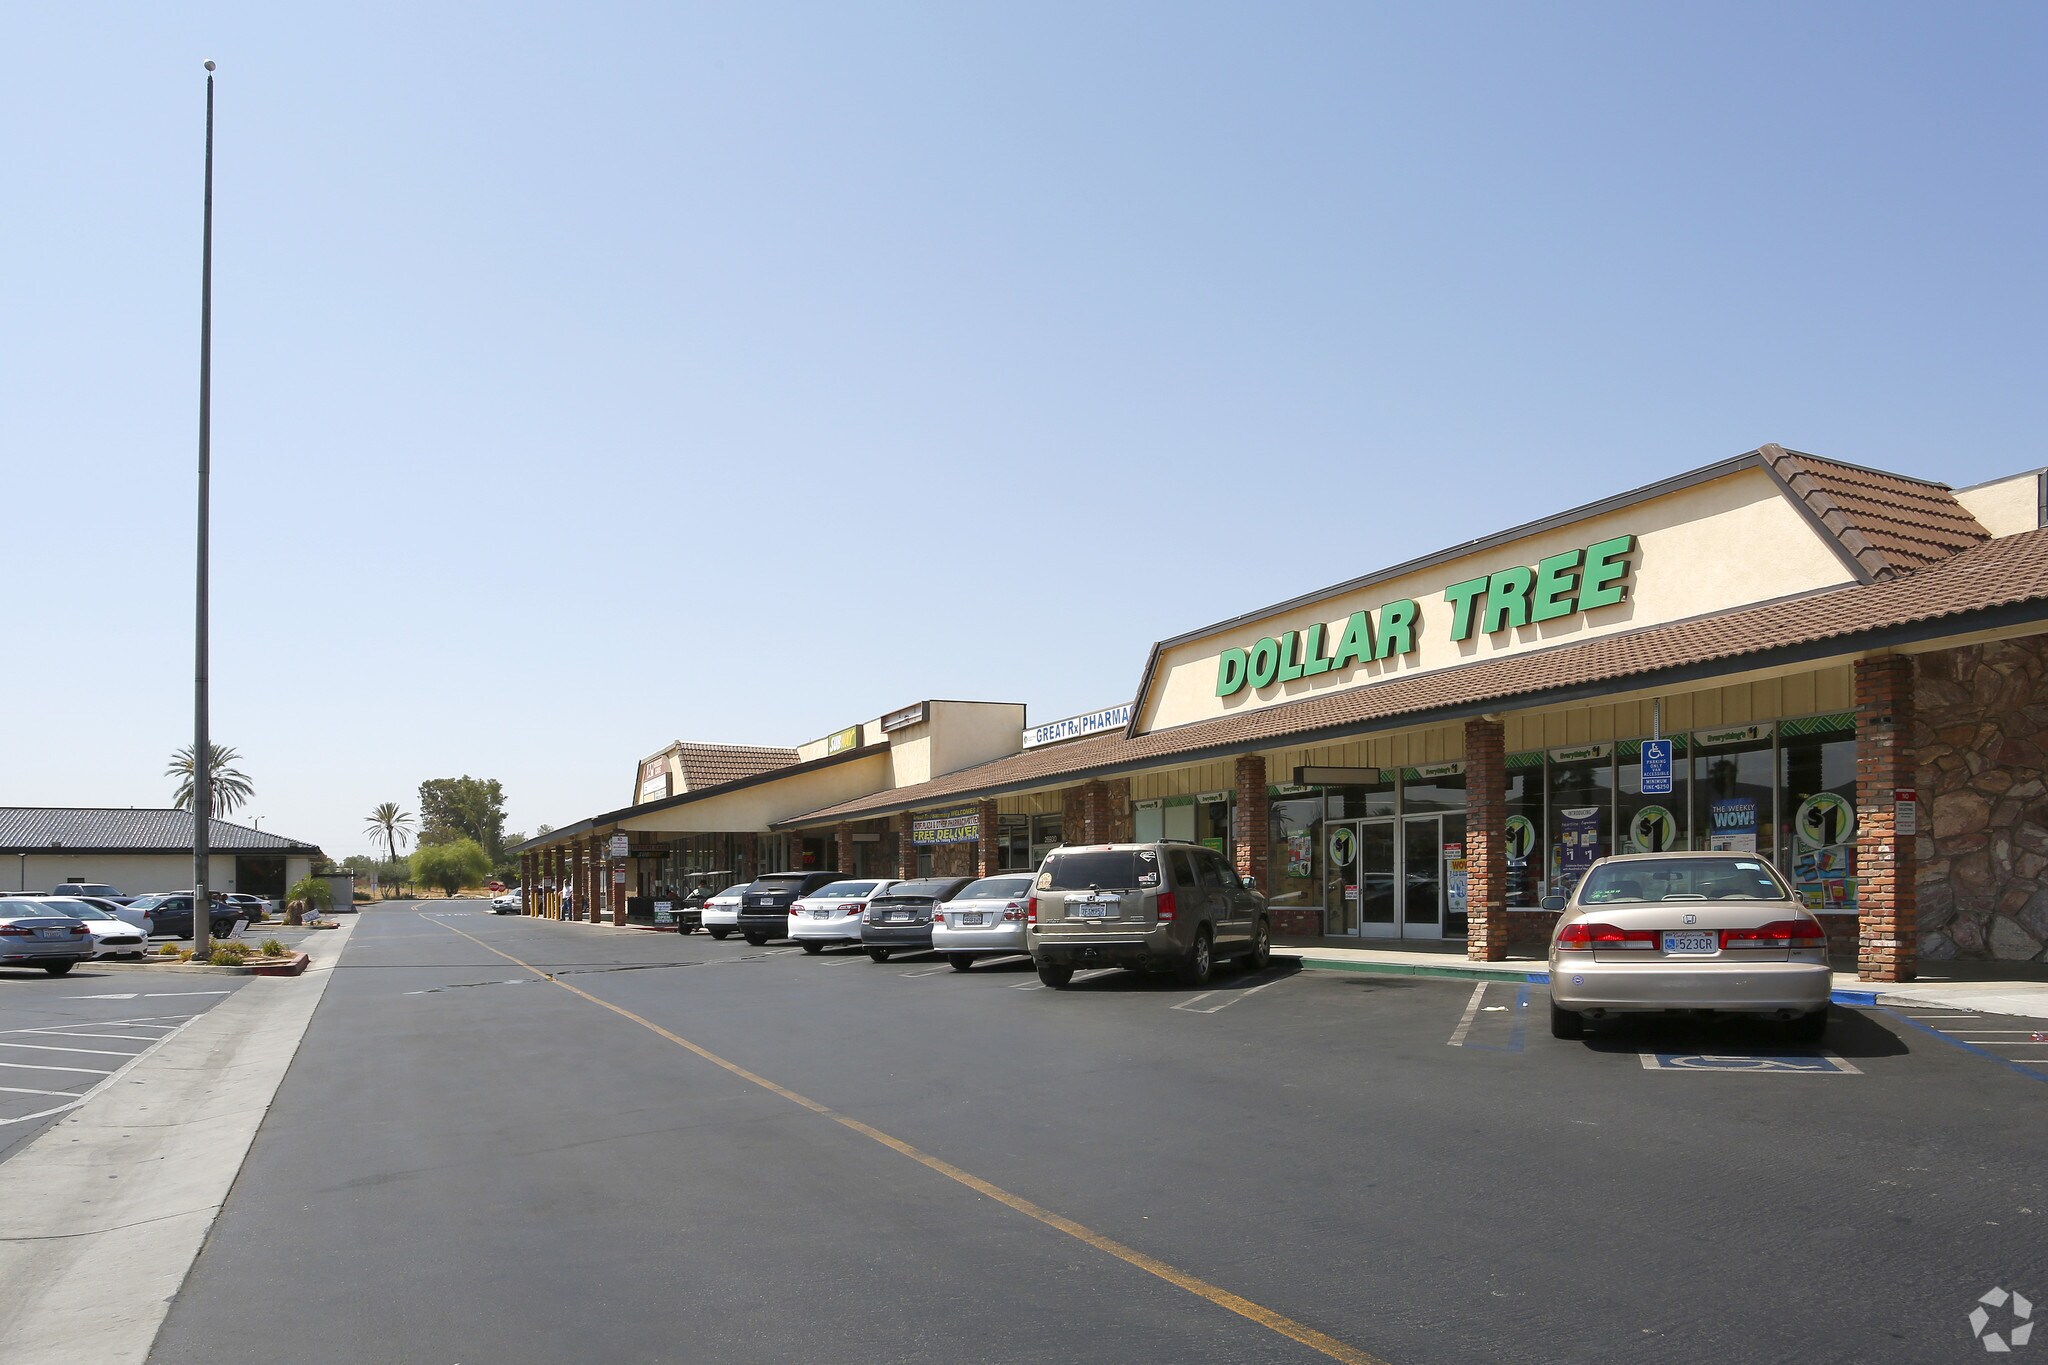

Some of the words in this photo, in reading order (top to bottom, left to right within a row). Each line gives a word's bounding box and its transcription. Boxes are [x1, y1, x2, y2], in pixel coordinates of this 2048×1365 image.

[1215, 598, 1421, 697] DOLLAR
[1445, 534, 1638, 641] TREE
[1036, 722, 1066, 743] GREAT
[1707, 730, 1746, 742] Everything's
[829, 728, 856, 753] SUBWAY
[1560, 750, 1590, 760] Everything's
[1712, 805, 1725, 813] THE
[1727, 804, 1755, 812] WEEKLY
[1713, 811, 1755, 828] WOW!
[913, 830, 935, 841] FREE
[936, 825, 979, 840] DELIVER
[1673, 931, 1703, 939] California
[1679, 938, 1713, 950] 523CR
